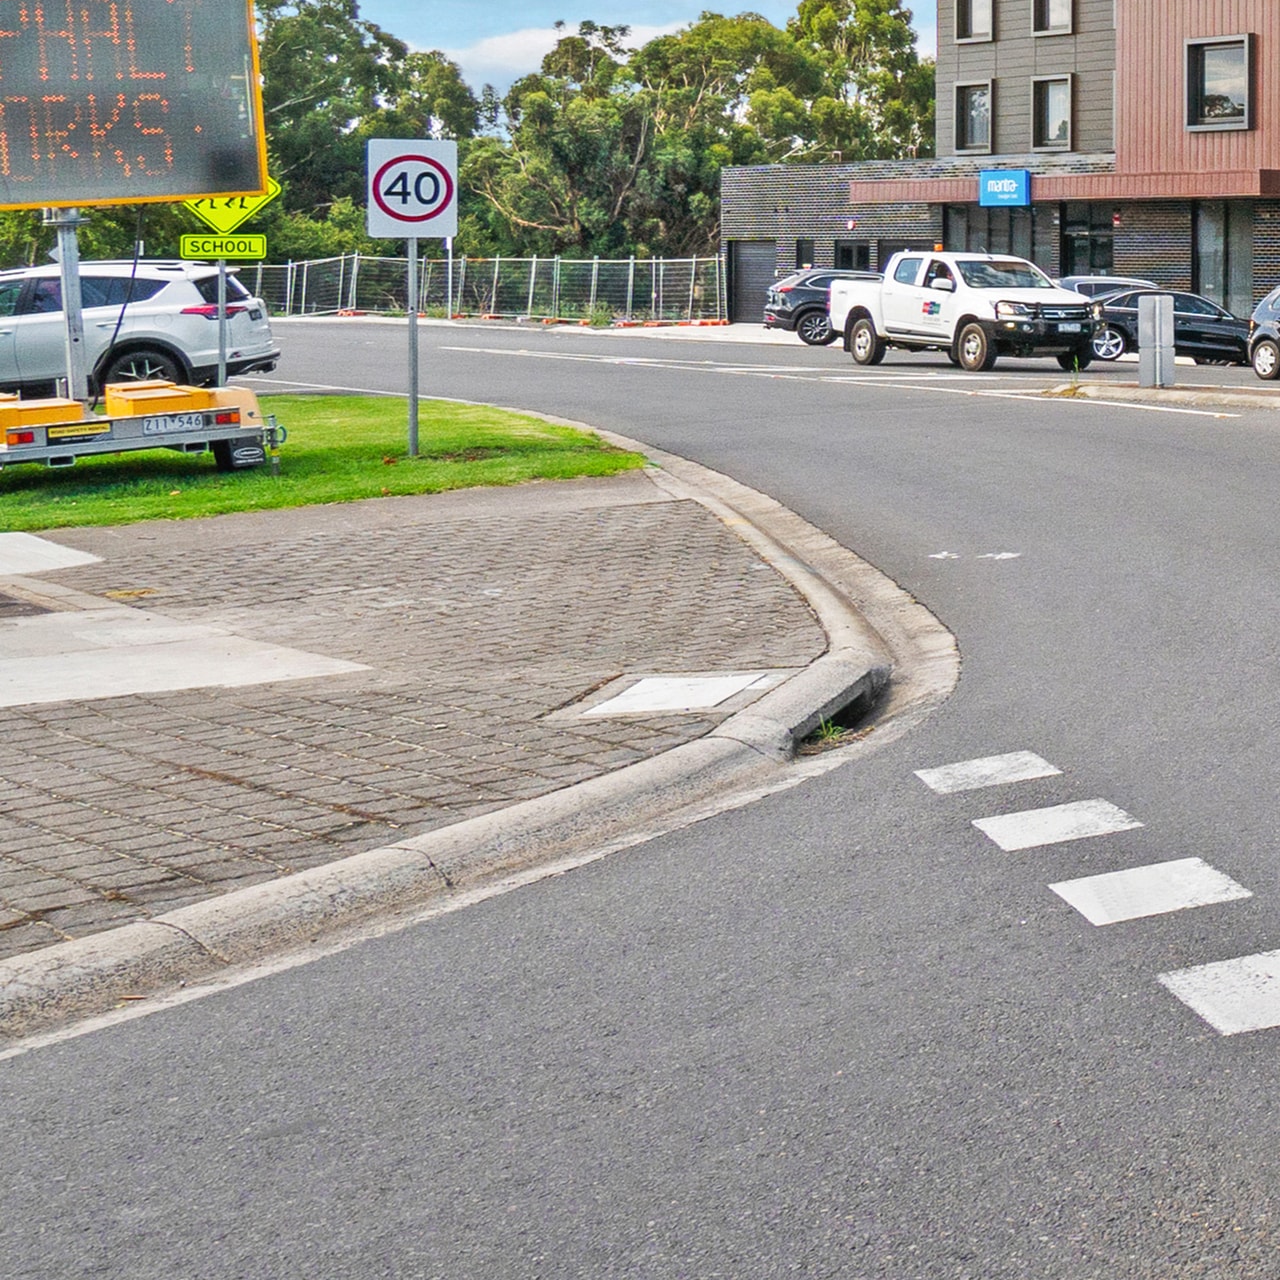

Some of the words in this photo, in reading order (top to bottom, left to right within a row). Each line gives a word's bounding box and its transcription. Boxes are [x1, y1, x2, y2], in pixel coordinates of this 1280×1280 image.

[383, 171, 440, 206] 40
[987, 178, 1019, 193] mantra
[190, 240, 258, 254] SCHOOL
